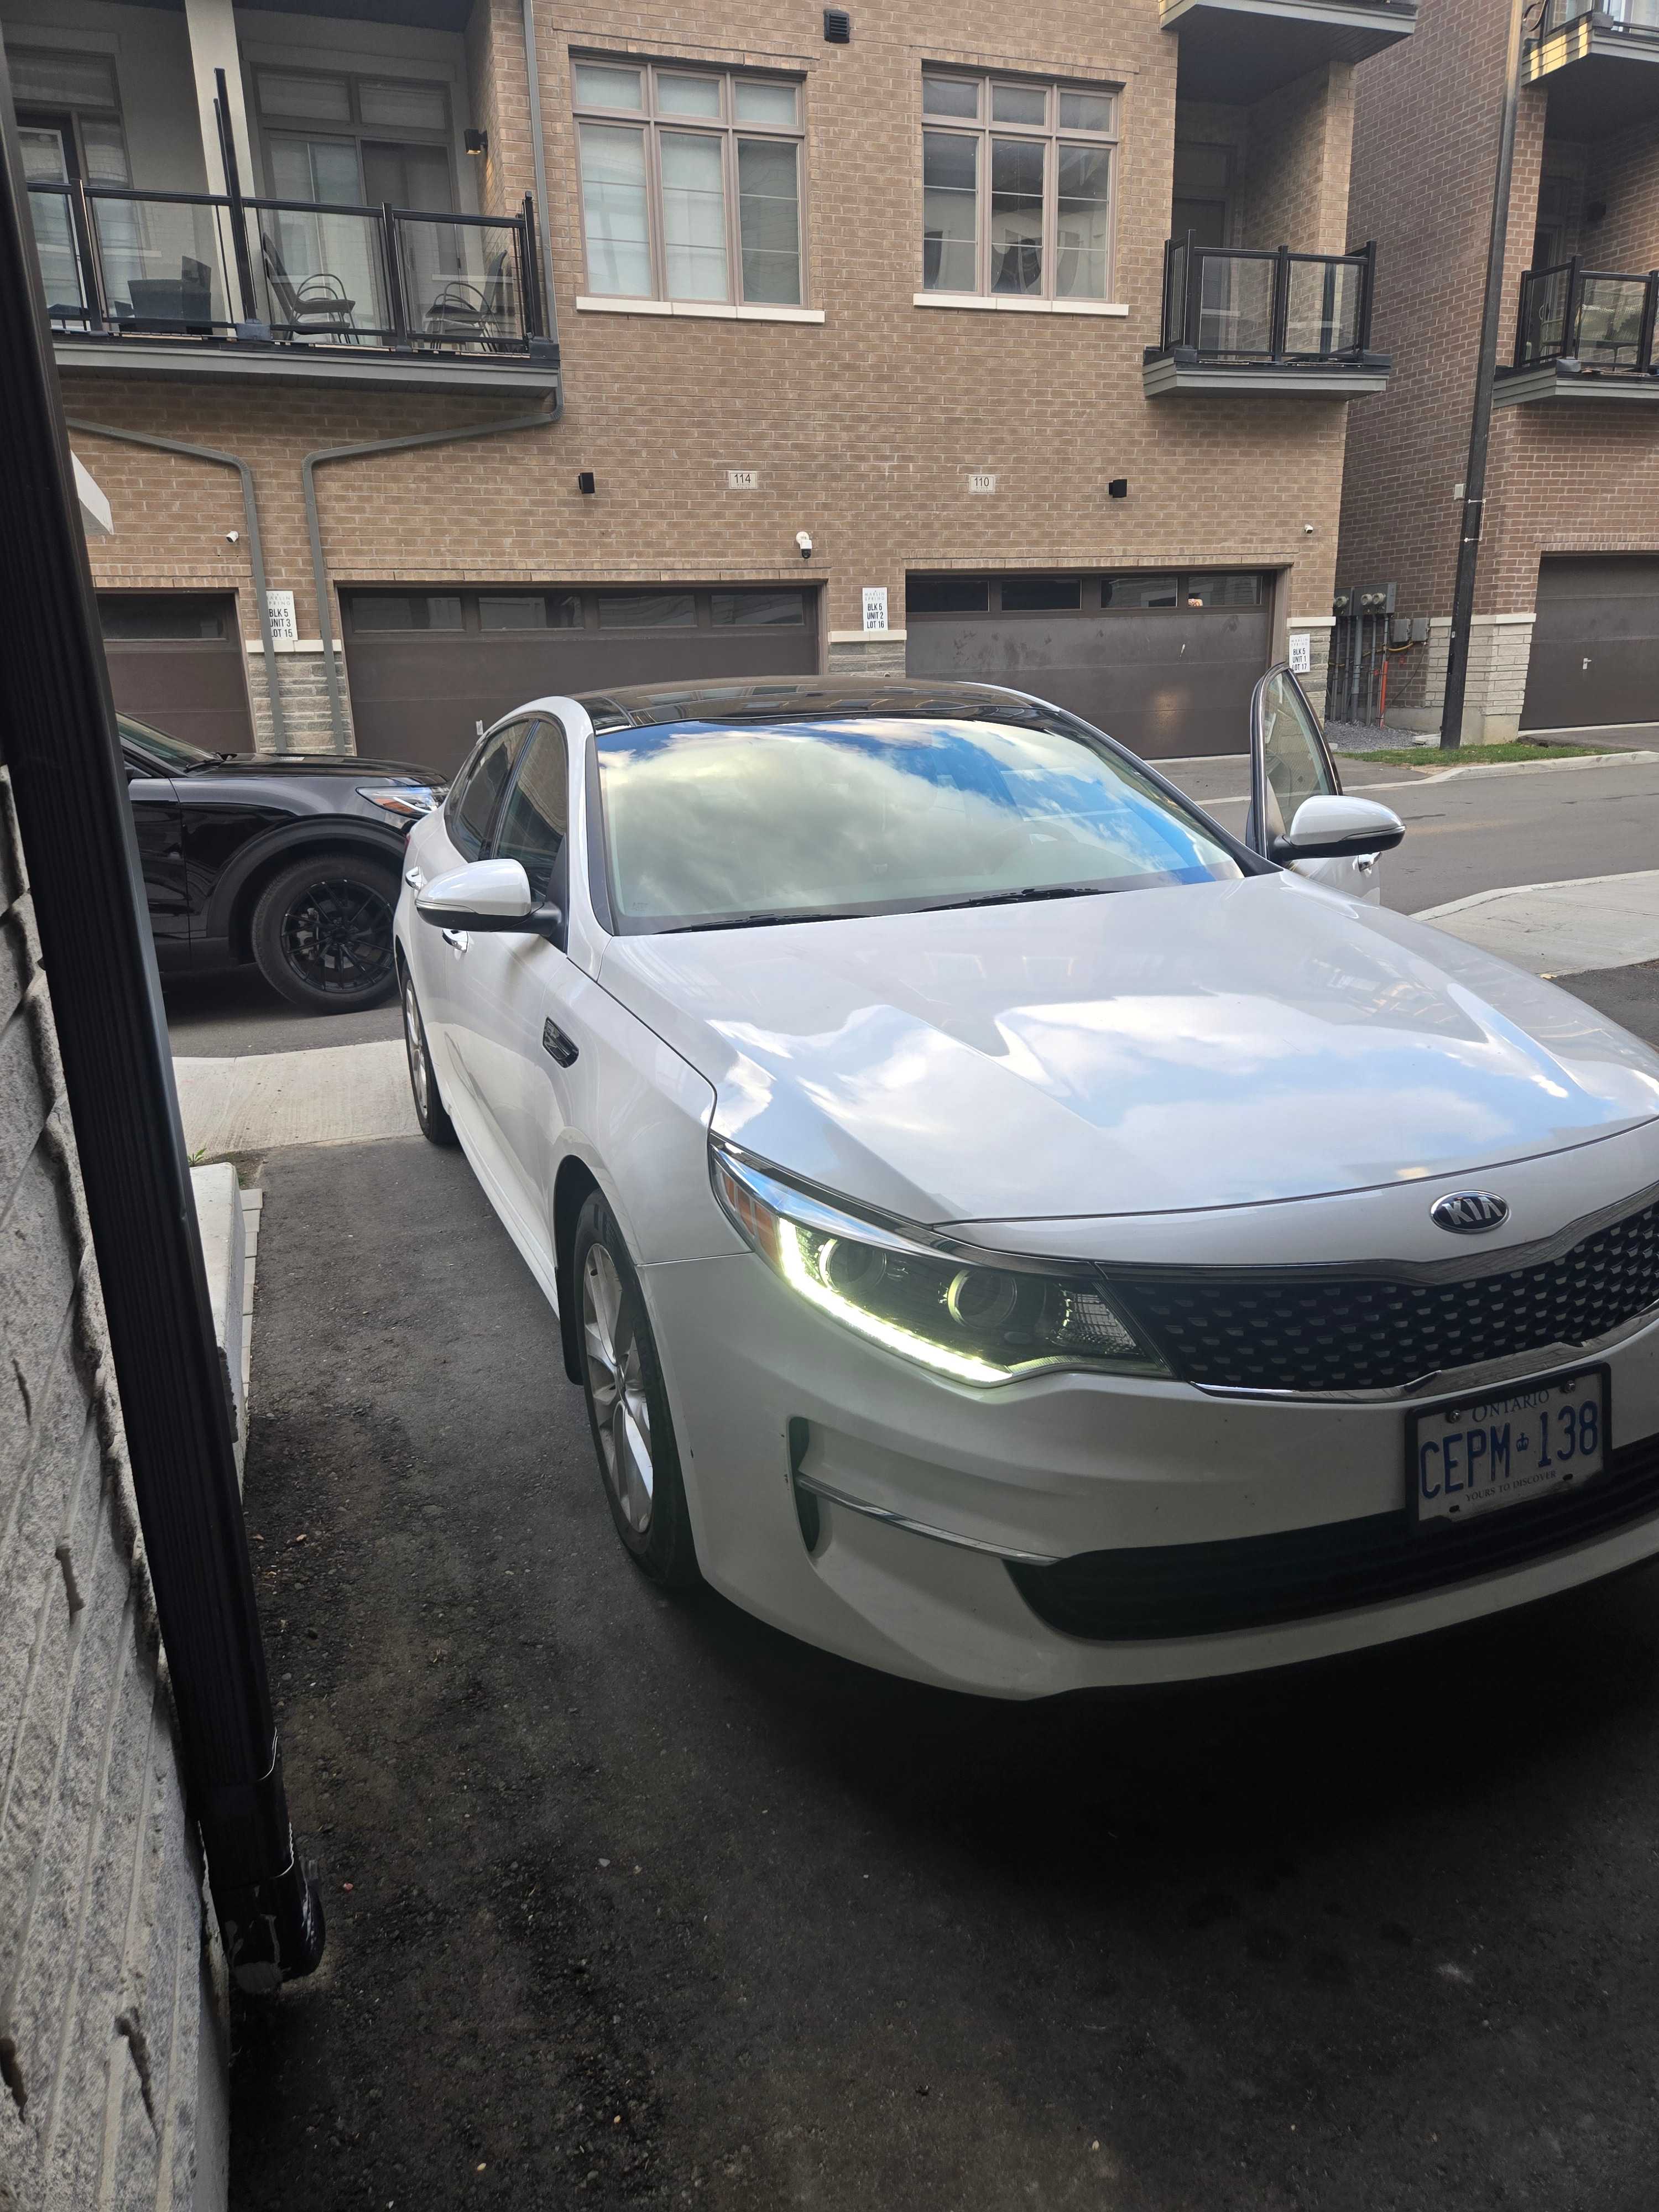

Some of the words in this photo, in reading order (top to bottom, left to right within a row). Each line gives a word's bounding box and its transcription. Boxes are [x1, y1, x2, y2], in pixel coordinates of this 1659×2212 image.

[734, 474, 751, 483] 114
[974, 477, 989, 487] 110
[269, 608, 283, 617] BLK
[284, 608, 288, 617] 5
[286, 618, 291, 627] 3
[272, 629, 281, 637] OT
[284, 629, 293, 637] 15
[1442, 1197, 1503, 1225] KIA
[1472, 1390, 1549, 1423] ONTARIO
[1420, 1422, 1511, 1500] CEPM
[1538, 1400, 1598, 1468] 138
[1465, 1488, 1496, 1502] YOURS
[1499, 1483, 1511, 1494] TO
[1512, 1470, 1557, 1489] DISCOVER
